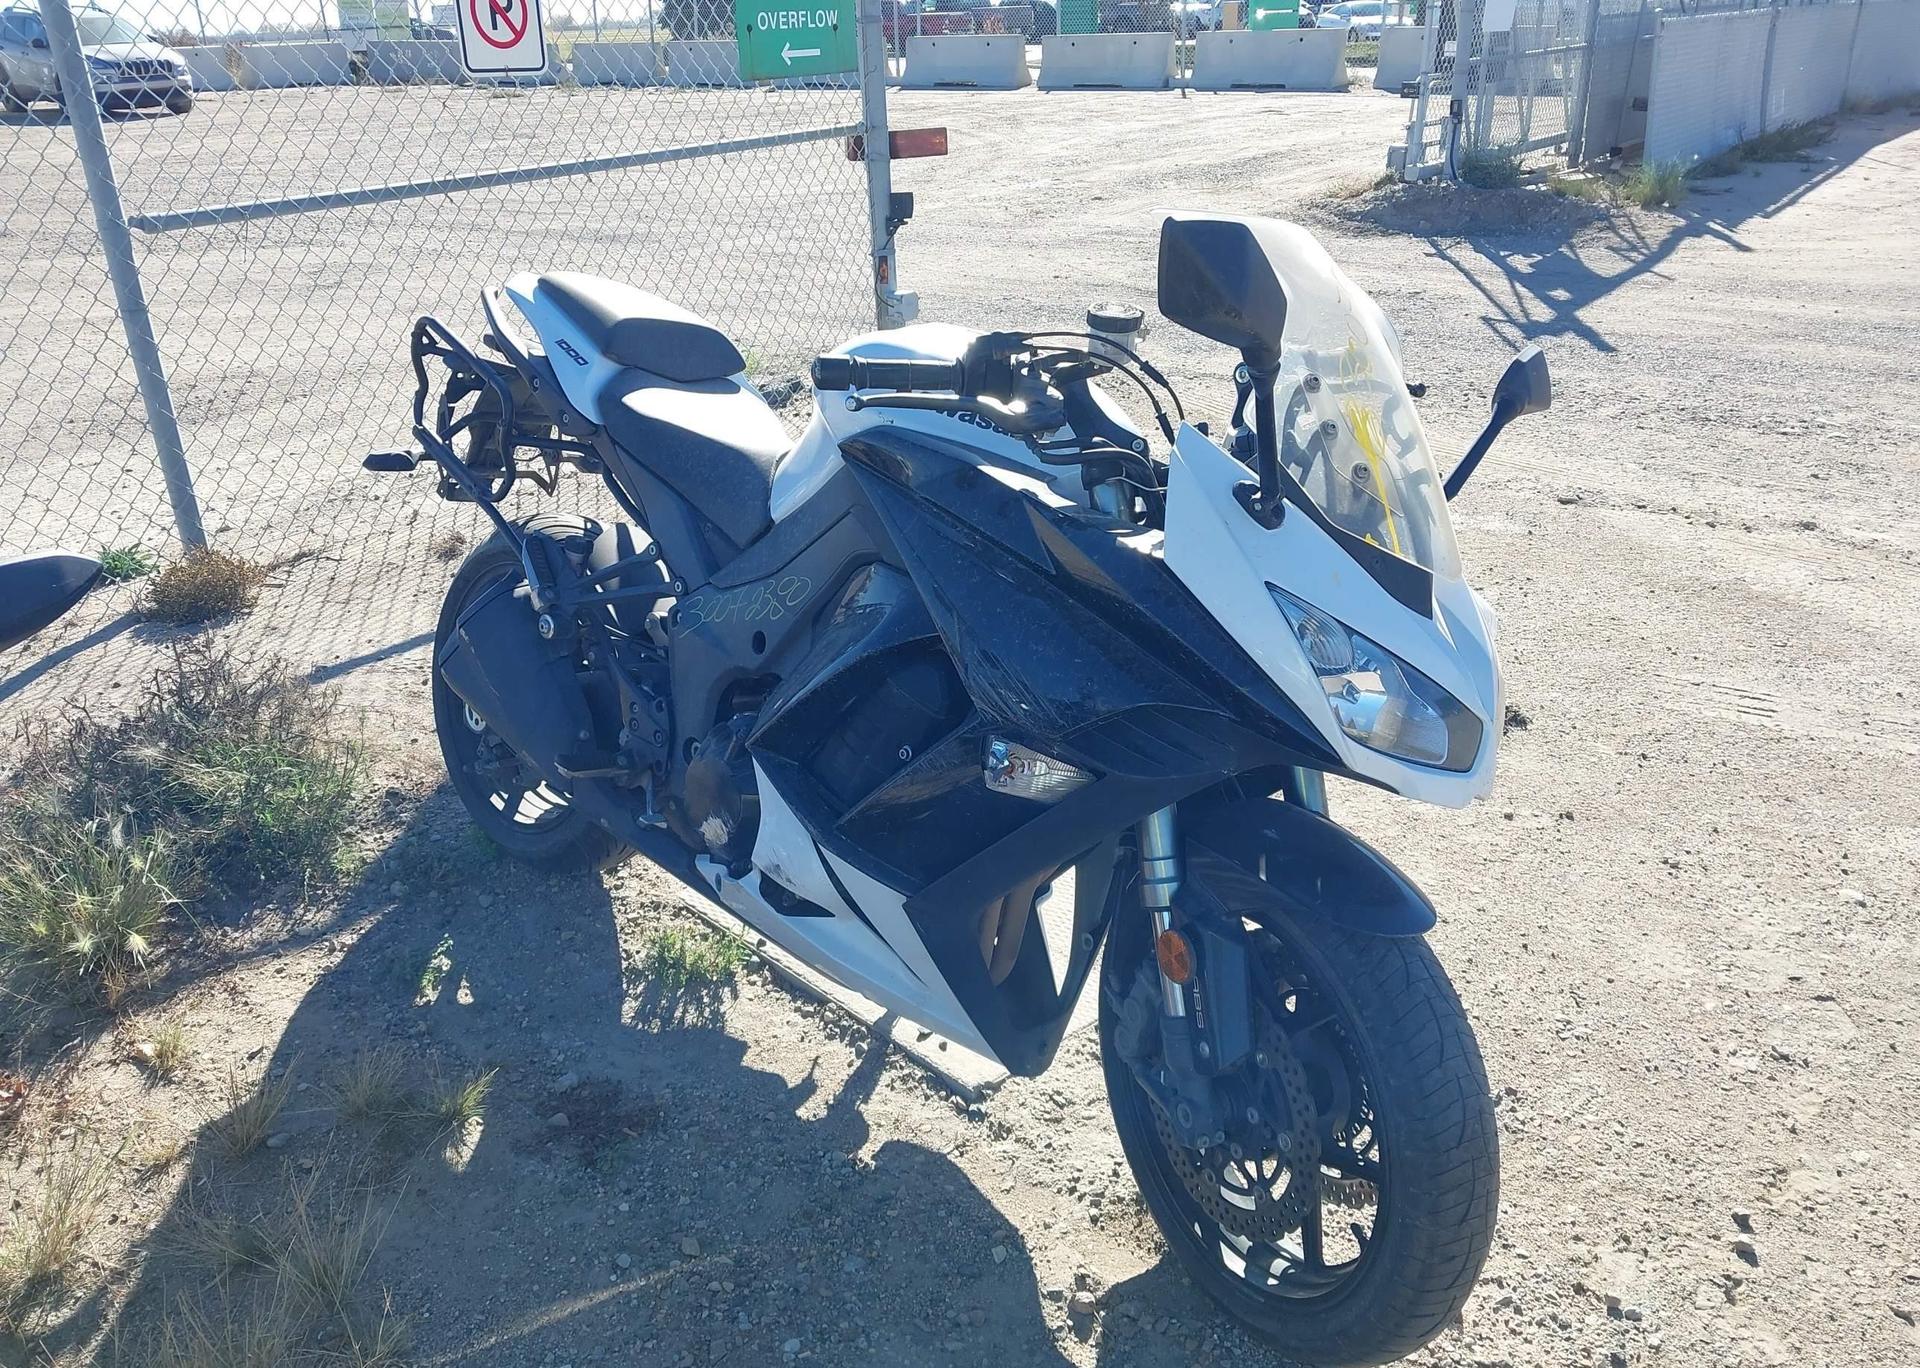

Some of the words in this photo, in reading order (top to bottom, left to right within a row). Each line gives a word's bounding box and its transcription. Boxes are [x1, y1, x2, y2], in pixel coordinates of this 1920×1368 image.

[757, 9, 838, 31] OVERFLOW
[554, 338, 589, 367] 1000
[1192, 975, 1204, 1029] ABS
